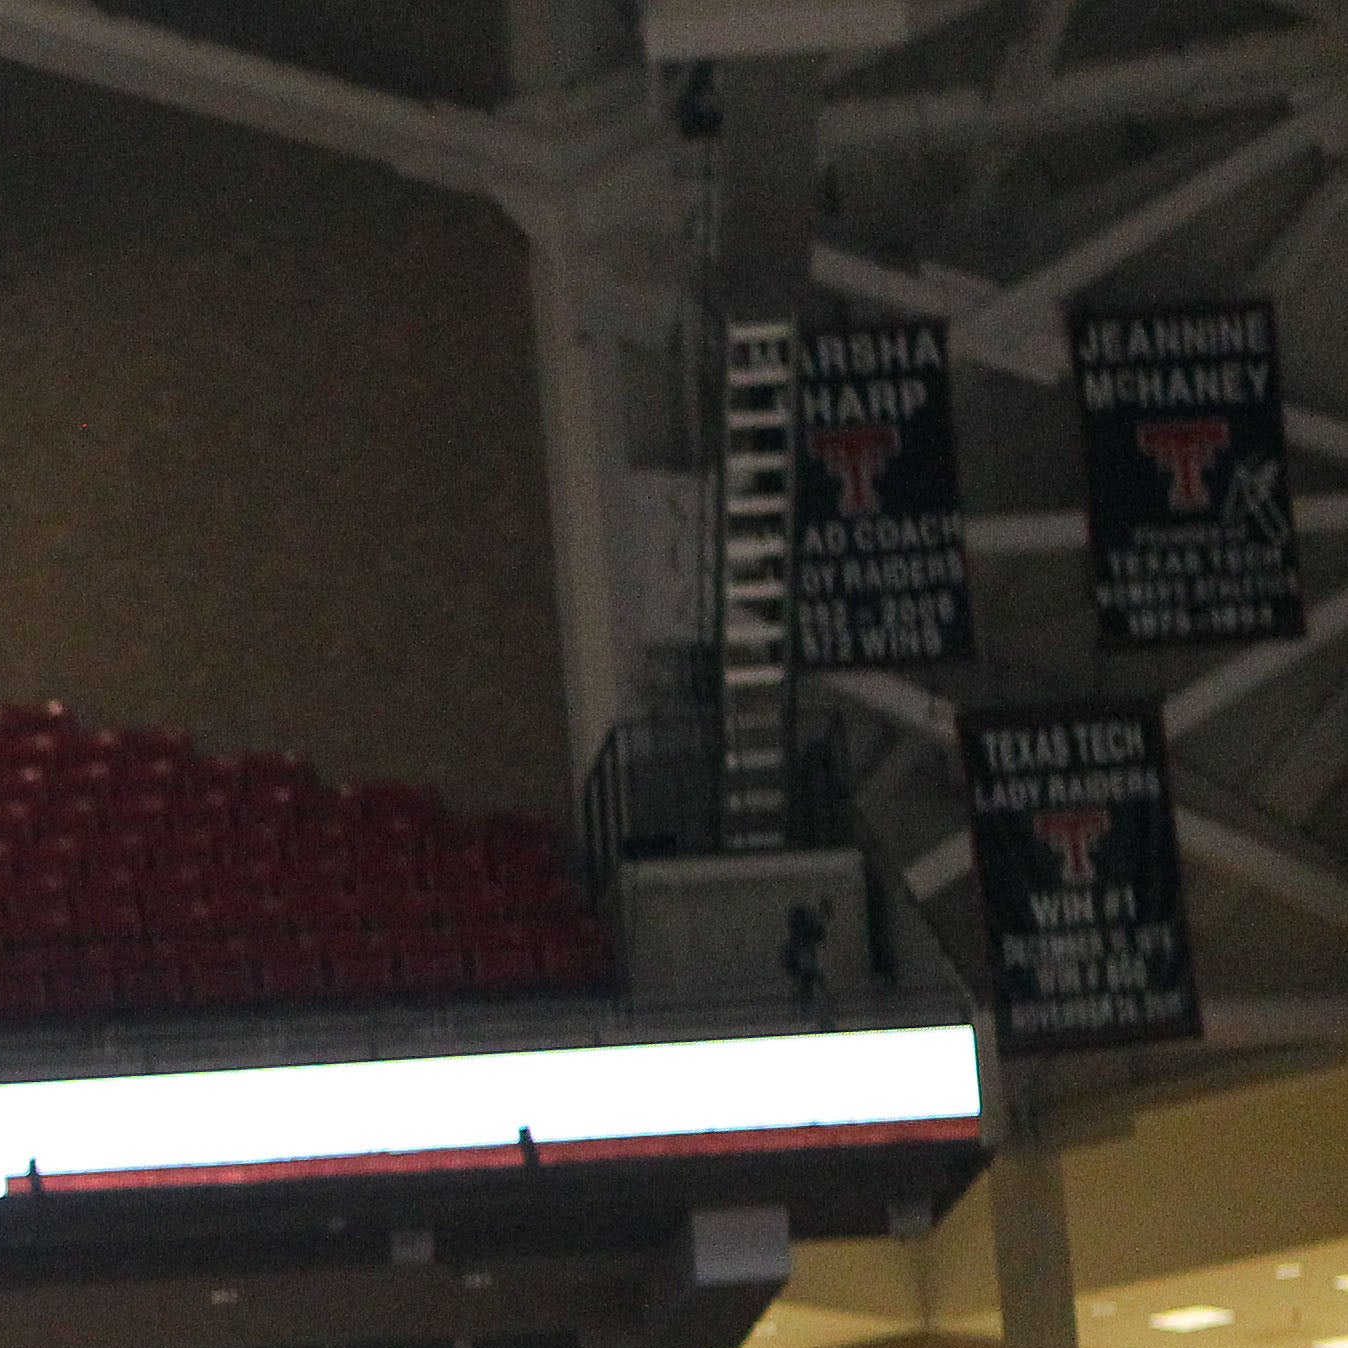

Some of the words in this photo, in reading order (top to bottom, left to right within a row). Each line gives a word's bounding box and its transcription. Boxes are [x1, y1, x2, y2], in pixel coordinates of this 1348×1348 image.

[1081, 312, 1271, 360] JEANNINE
[778, 379, 926, 421] HARP
[982, 724, 1071, 770] TEXAS
[1072, 721, 1144, 764] TECH
[1030, 888, 1095, 927] WIN
